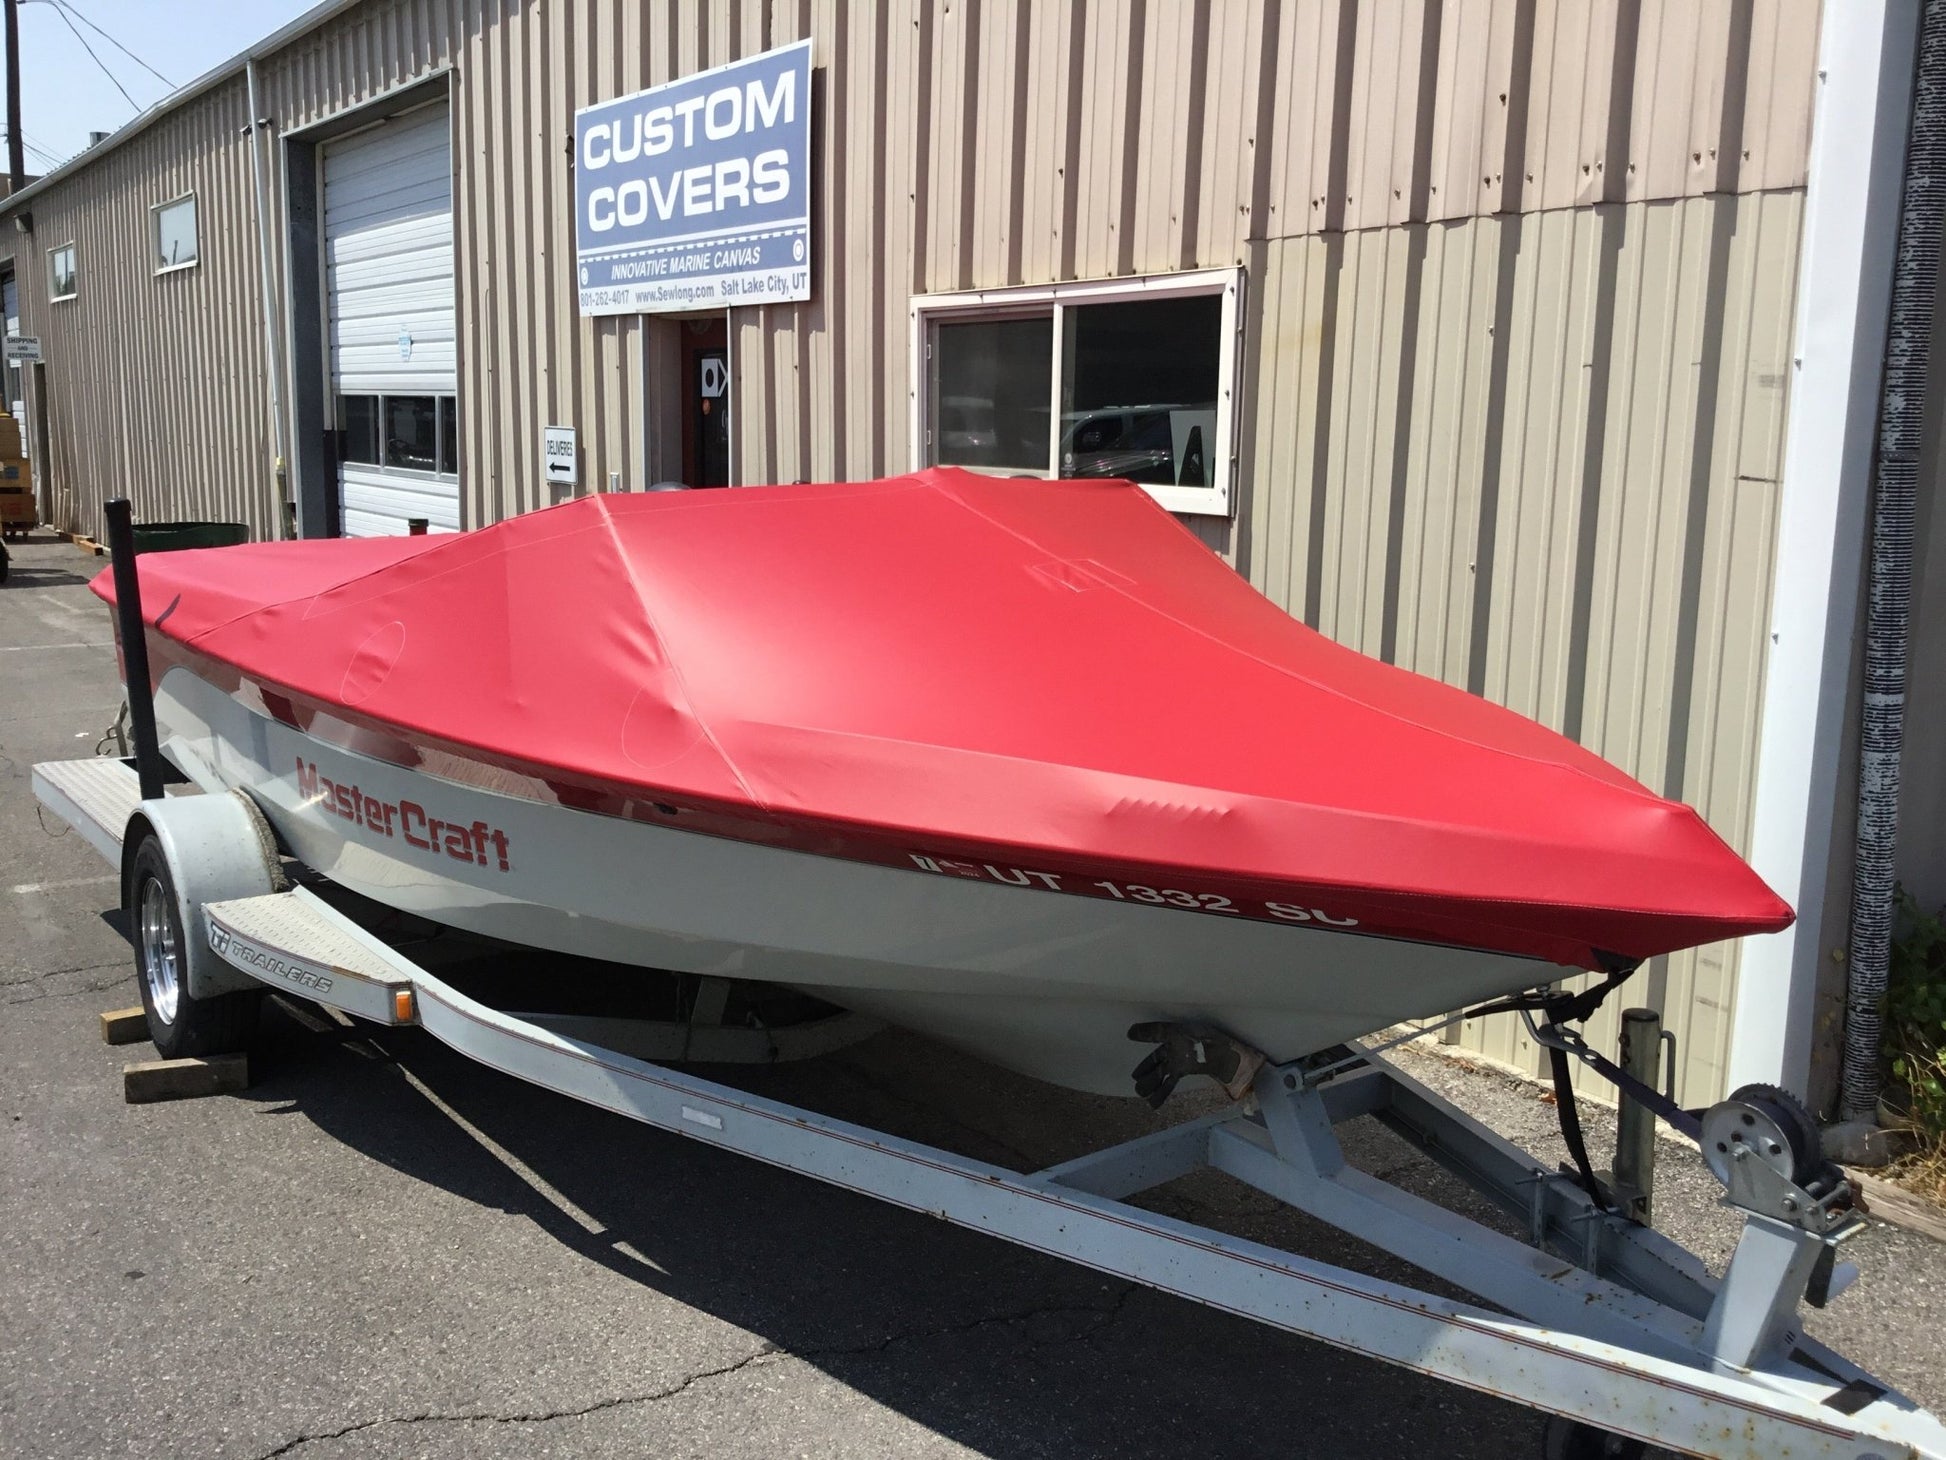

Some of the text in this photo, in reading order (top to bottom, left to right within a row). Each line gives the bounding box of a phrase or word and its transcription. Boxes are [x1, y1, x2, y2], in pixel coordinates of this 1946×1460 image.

[583, 69, 796, 171] CUSTOM
[588, 148, 791, 232] COVERS
[580, 272, 807, 308] 801-262-4017 www.Sewlong.com Salt Lake City, UT
[611, 246, 761, 281] INNOVATIVE MARINE CANVAS
[296, 756, 509, 872] MasterCraft
[983, 864, 1062, 890] UT
[1094, 881, 1239, 913] 1332
[231, 940, 333, 994] TRAILERS
